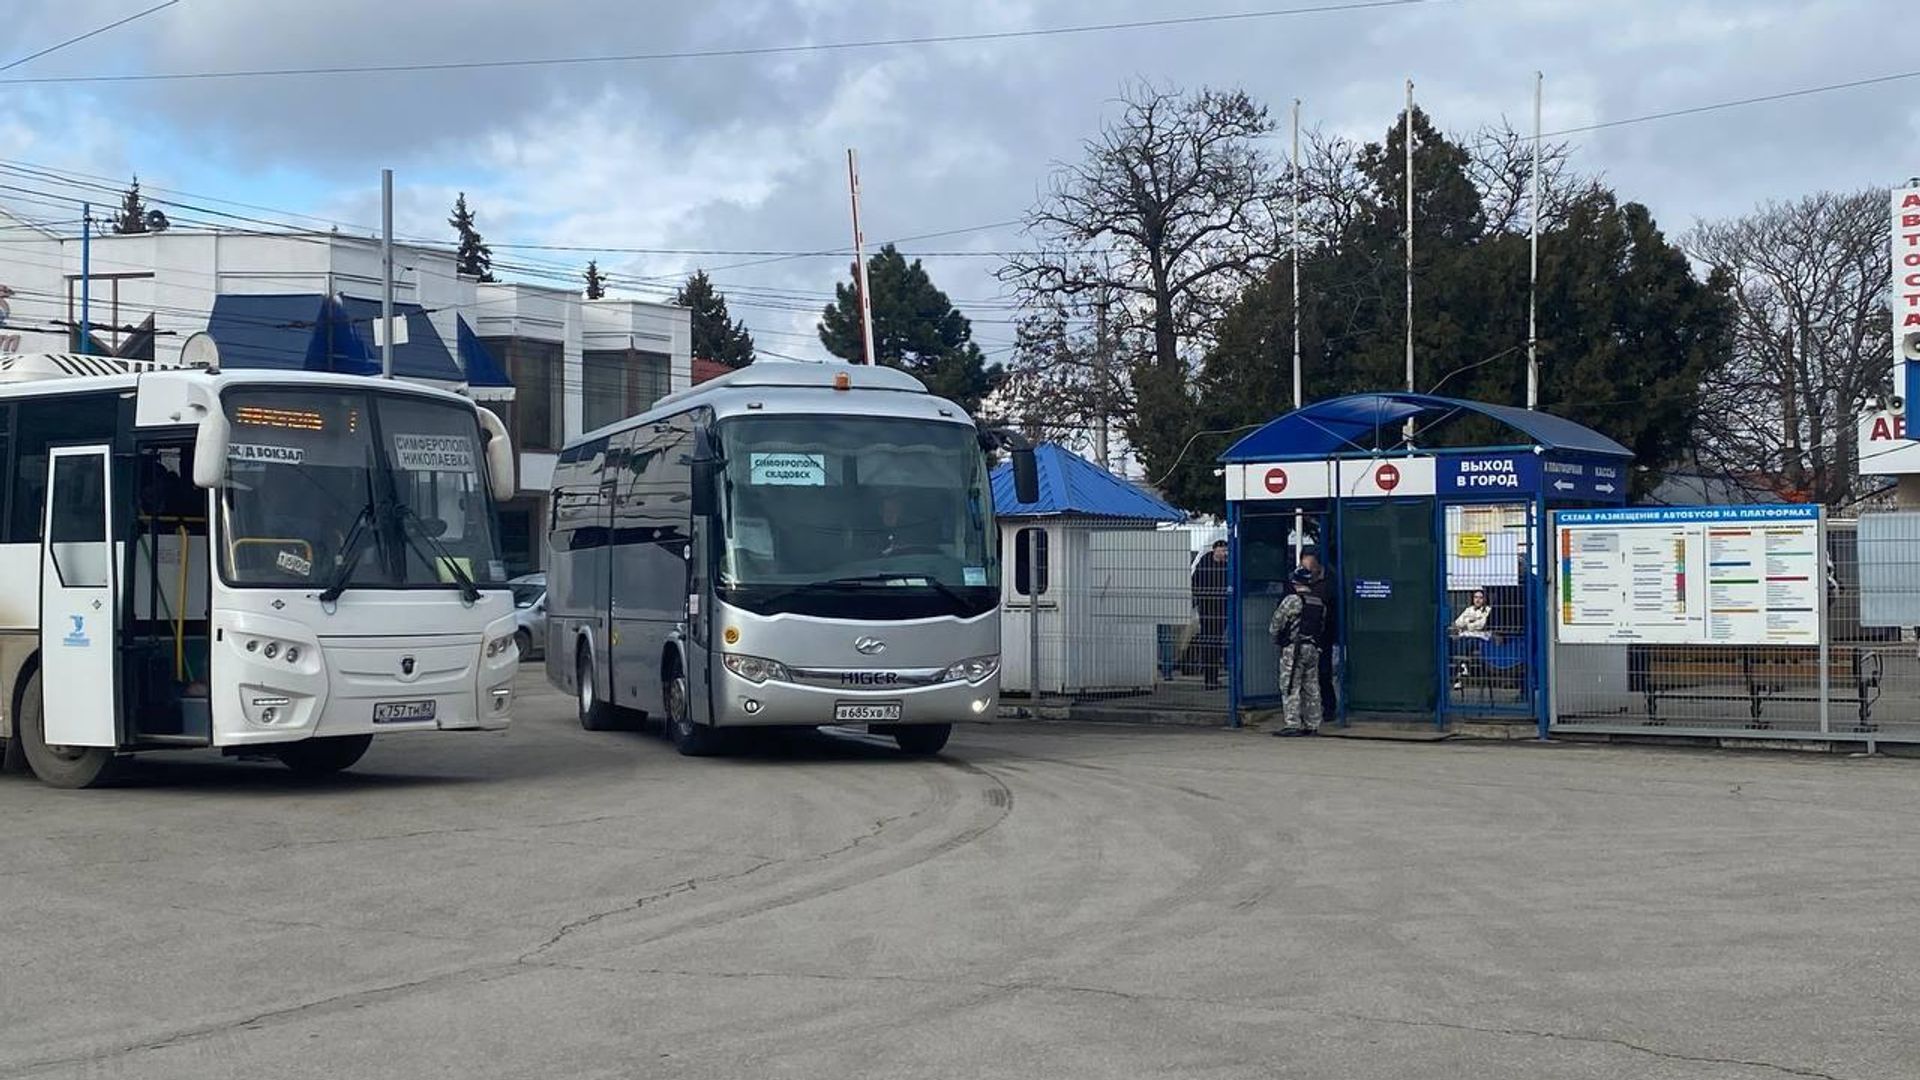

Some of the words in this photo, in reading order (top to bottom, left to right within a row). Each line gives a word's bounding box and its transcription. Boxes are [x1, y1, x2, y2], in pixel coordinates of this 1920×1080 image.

[396, 436, 473, 452] СИМФЕРОПОЛЬ
[257, 447, 303, 461] ВОКЗАЛ
[401, 451, 470, 466] НИКОЛАЕВКА
[1461, 460, 1514, 472] ВЫХОД
[765, 470, 811, 479] СКАДОВСК
[1457, 476, 1466, 486] В
[1470, 474, 1518, 486] ГОРОД
[1561, 513, 1592, 521] СХЕМА
[1595, 512, 1660, 521] РАЗМЕЩЕНИЯ
[1663, 511, 1720, 519] АВТОБУСОВ
[1723, 510, 1735, 518] НА
[1741, 508, 1812, 517] ПЛАТФОРМАХ
[841, 672, 898, 684] HIGER
